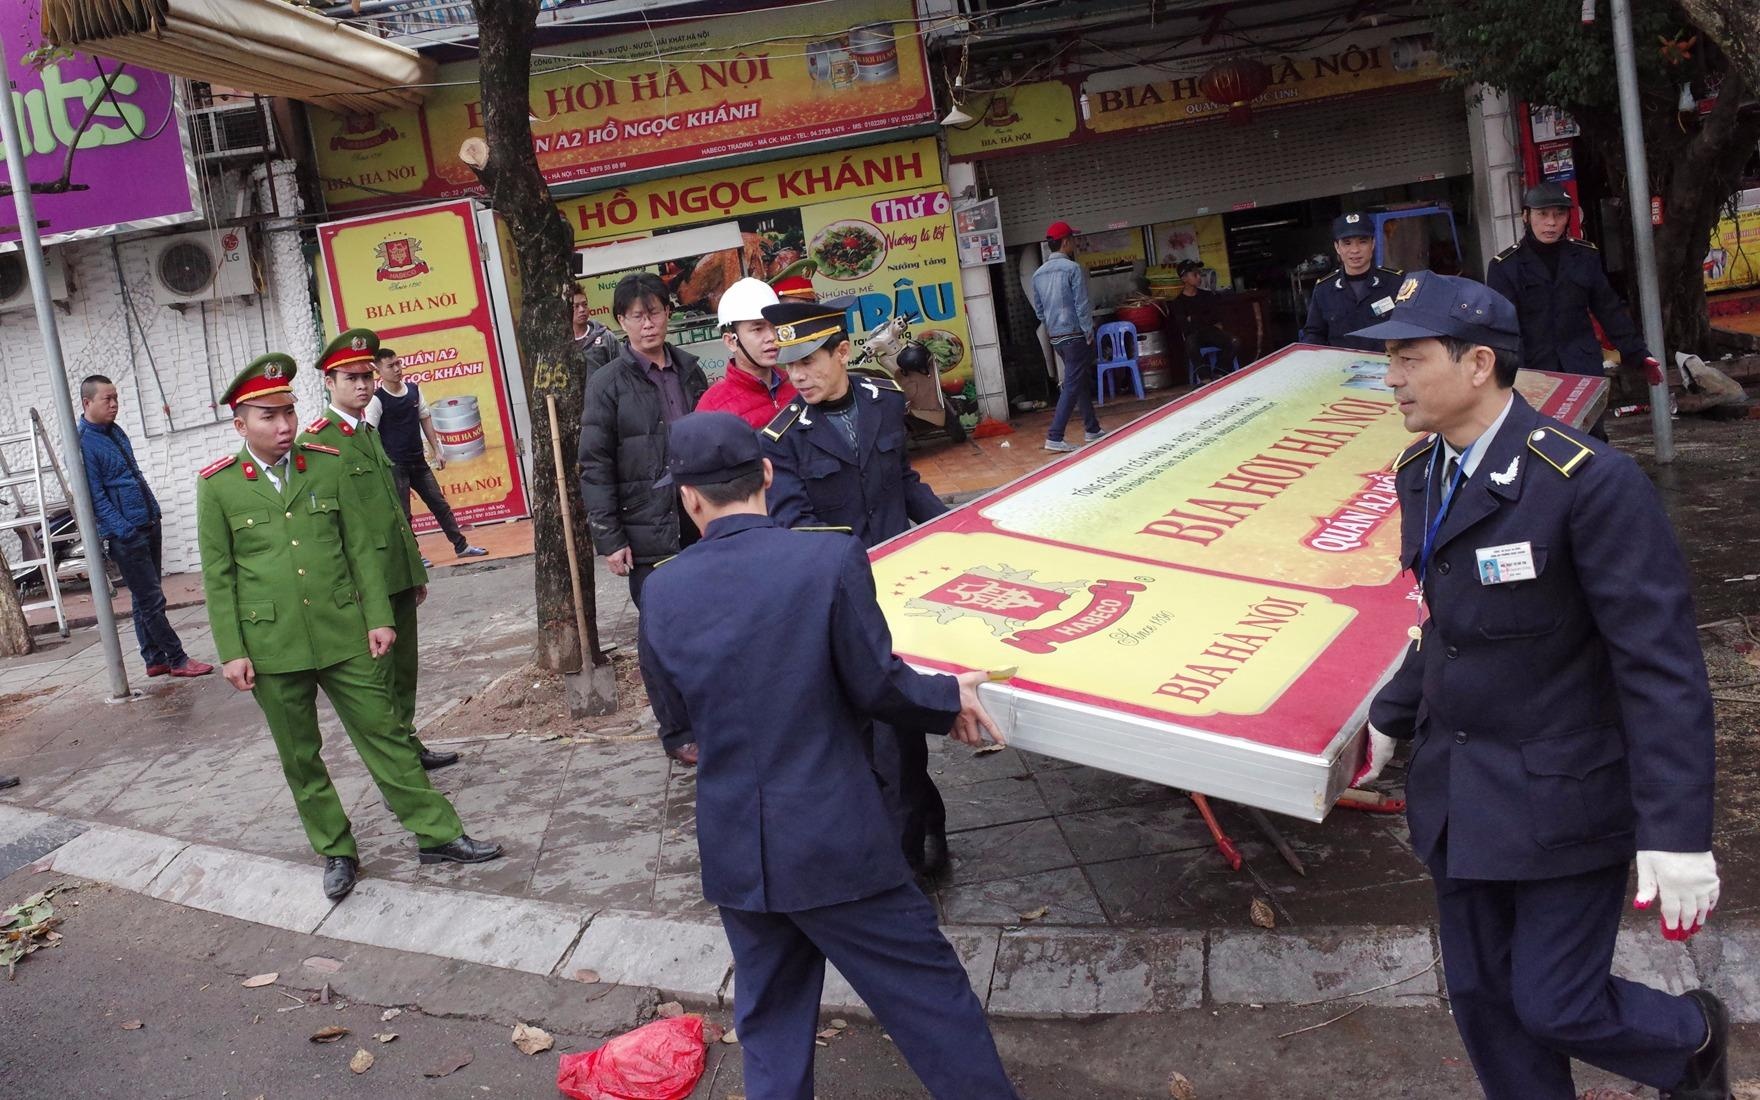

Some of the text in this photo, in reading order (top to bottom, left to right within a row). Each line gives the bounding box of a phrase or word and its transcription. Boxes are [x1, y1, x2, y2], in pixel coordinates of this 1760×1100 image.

[545, 46, 774, 116] HƠI HÀ NỘI
[1097, 83, 1165, 113] BIA
[1314, 44, 1383, 77] NỘI
[556, 131, 582, 149] A2
[588, 120, 618, 145] HỒ
[624, 116, 681, 138] NGỌC
[687, 102, 758, 128] KHÁNH
[701, 145, 727, 155] HABECO
[727, 141, 755, 152] TRADING
[981, 138, 998, 147] BIA
[579, 152, 923, 231] HỒ NGỌC KHÁNH
[875, 191, 950, 223] Thứ 6
[884, 230, 918, 251] Nướng
[921, 228, 931, 243] lá
[226, 253, 240, 262] LG
[816, 287, 857, 300] NHÚNG
[846, 277, 957, 334] TRÂU
[366, 305, 396, 320] BIA
[400, 348, 457, 368] QUÁN A2
[434, 362, 484, 380] KHÁNH
[700, 357, 725, 371] Xào
[1135, 397, 1400, 547] BIA HƠI HÀ NỘI
[1311, 518, 1381, 551] QUÁN
[1354, 494, 1399, 514] A2
[1055, 598, 1123, 638] HABECO
[1153, 595, 1309, 705] BIA HÀ NỘI
